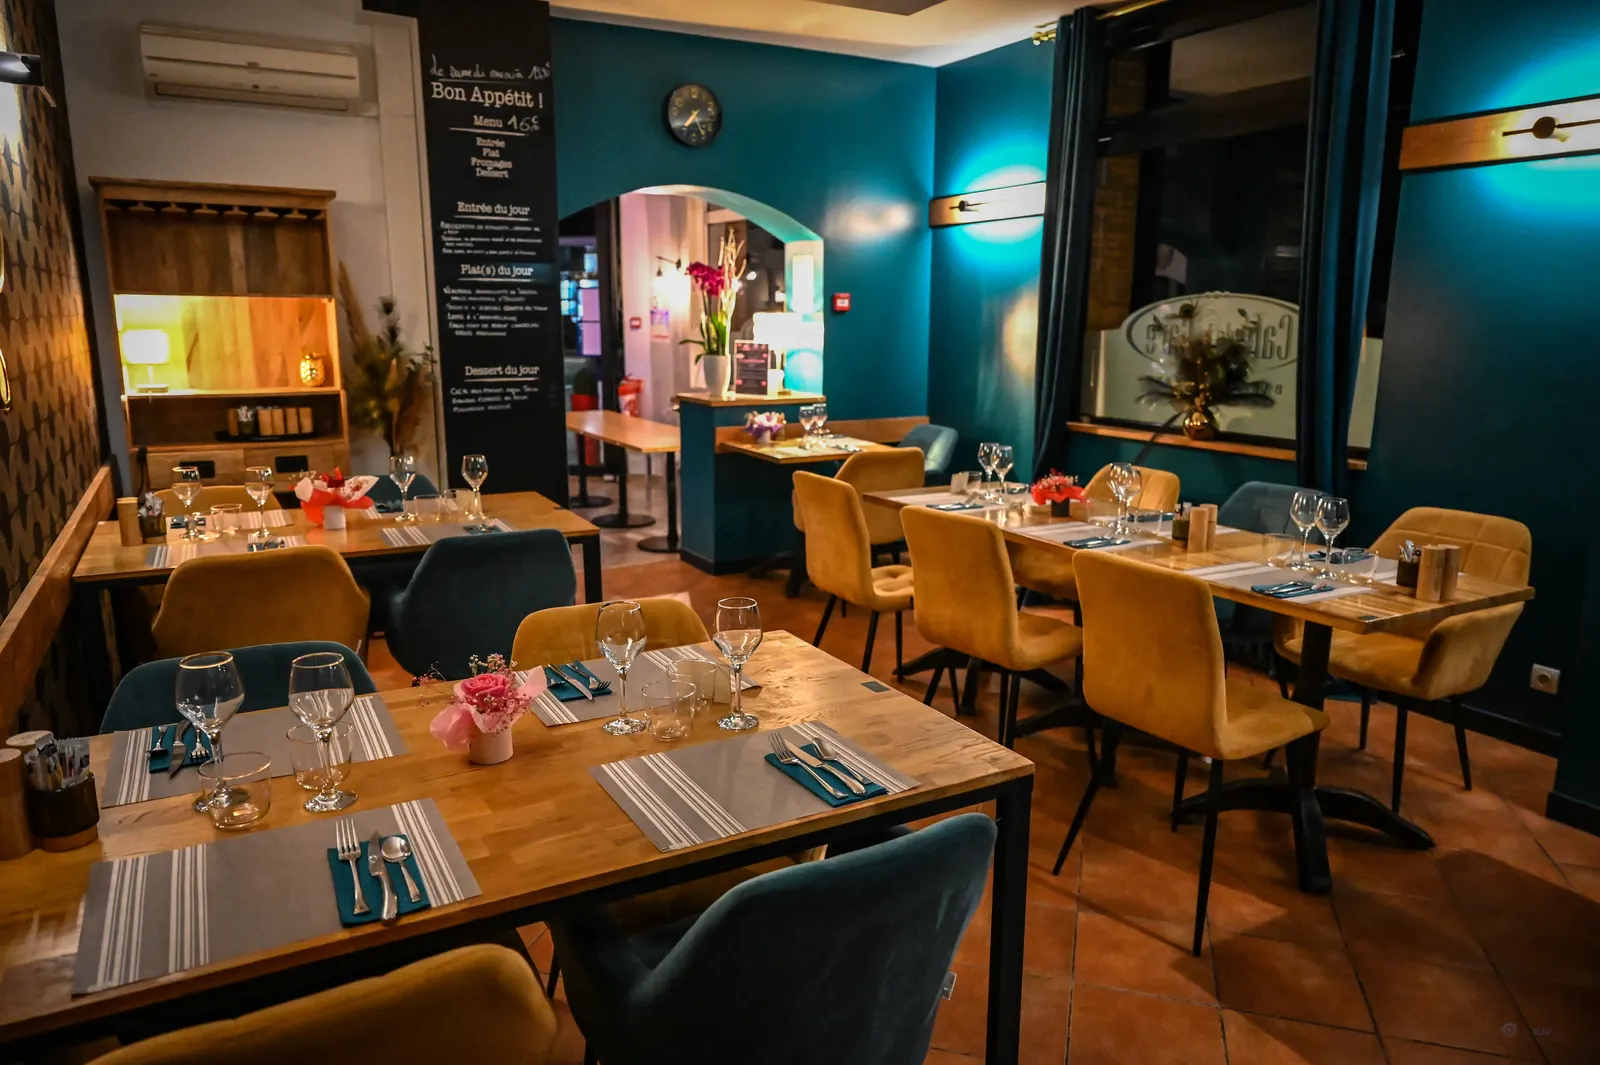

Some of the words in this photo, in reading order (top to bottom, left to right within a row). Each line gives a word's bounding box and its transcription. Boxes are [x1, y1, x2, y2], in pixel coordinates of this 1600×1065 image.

[431, 81, 467, 101] Bon
[470, 86, 534, 108] Appétit
[538, 92, 543, 109] !
[473, 115, 503, 128] Menu
[476, 137, 505, 148] Entrée
[482, 148, 500, 157] Plat
[471, 157, 512, 169] Fromages
[476, 168, 508, 178] Dessert
[457, 201, 492, 213] Entrée
[494, 203, 507, 214] du
[508, 204, 530, 216] jour
[460, 263, 496, 277] Plat(s)
[497, 265, 511, 275] du
[511, 265, 534, 277] jour
[465, 366, 503, 376] Dessert
[505, 365, 517, 375] du
[518, 365, 540, 376] jour
